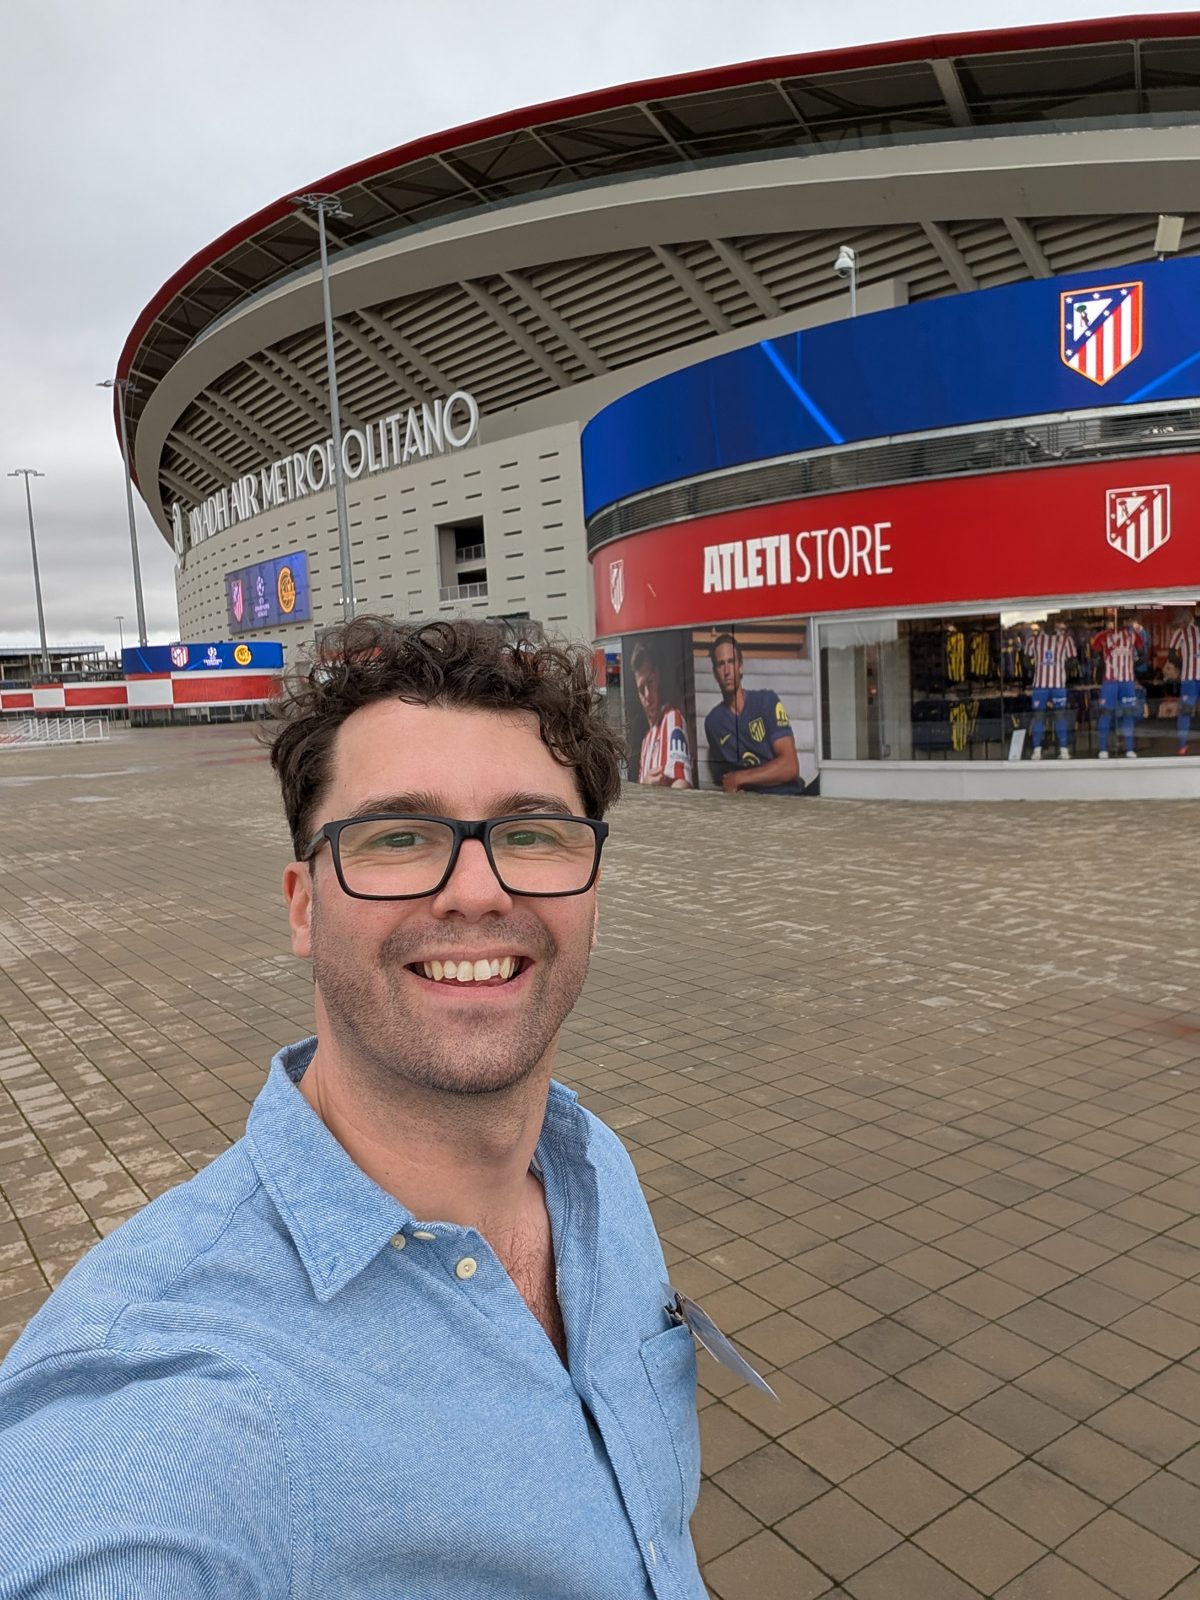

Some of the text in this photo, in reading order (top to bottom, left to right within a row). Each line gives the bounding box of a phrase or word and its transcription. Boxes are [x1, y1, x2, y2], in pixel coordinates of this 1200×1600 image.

[232, 473, 261, 525] AIR
[703, 522, 893, 594] ATLETI STORE
